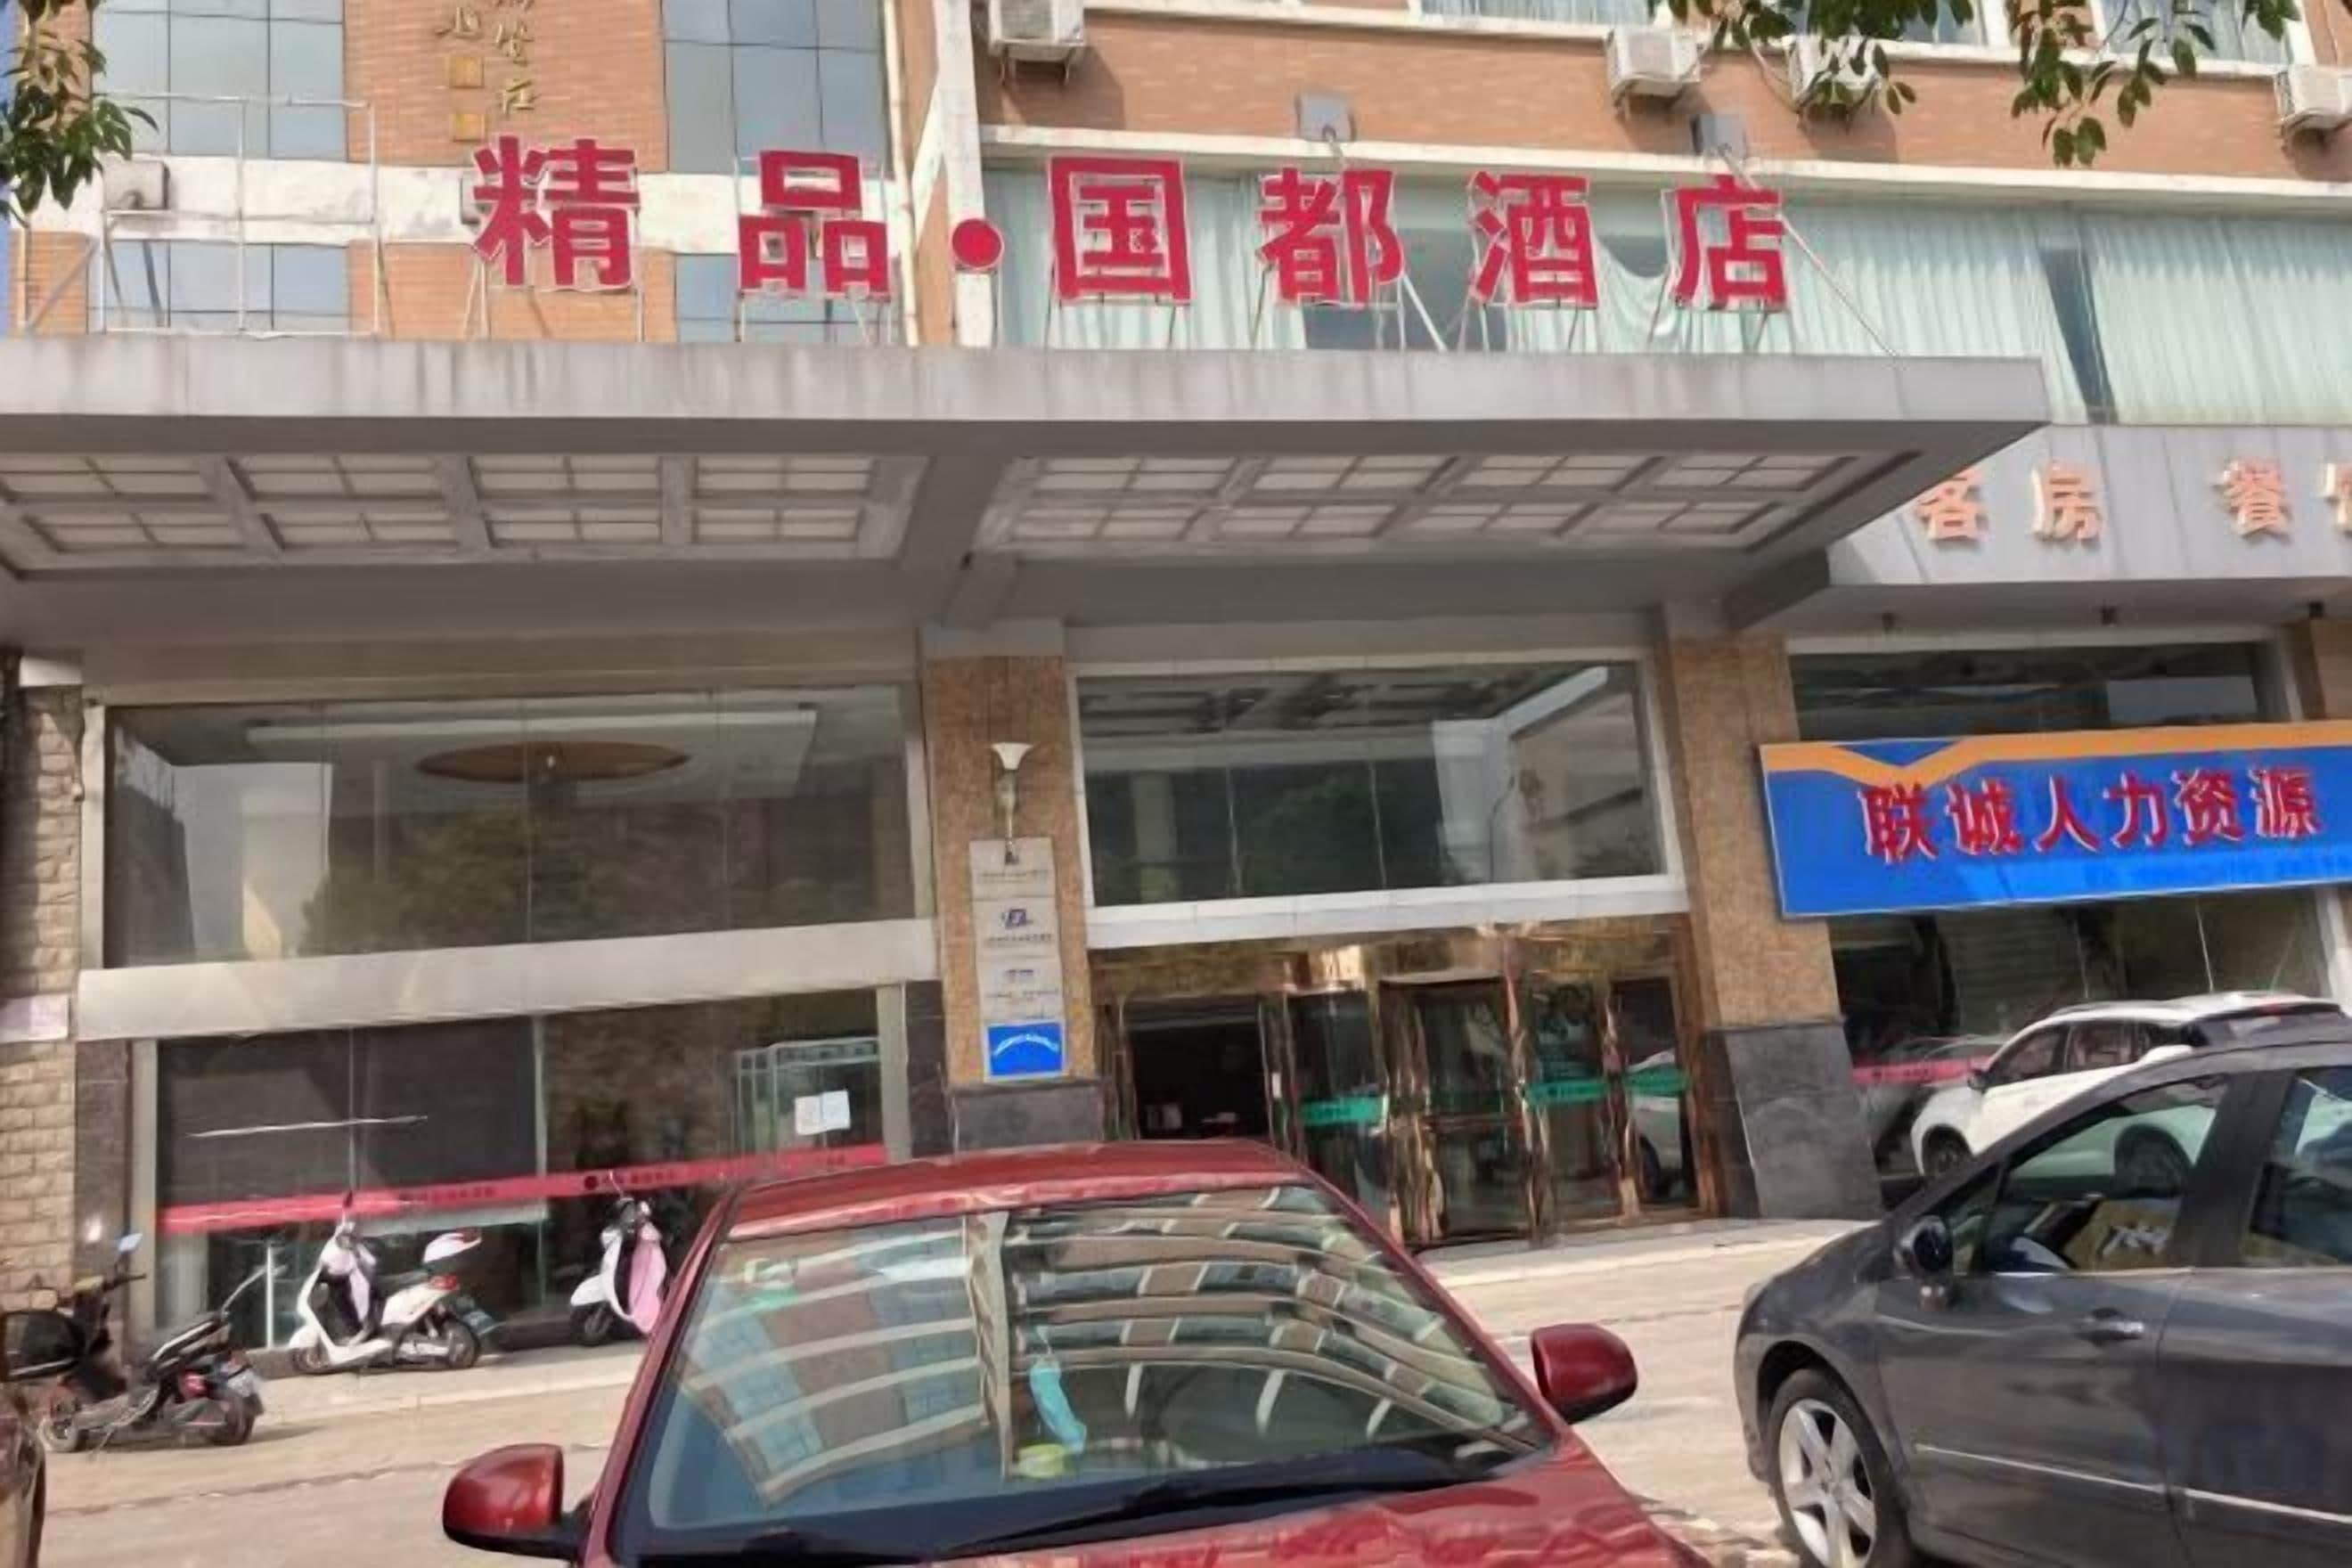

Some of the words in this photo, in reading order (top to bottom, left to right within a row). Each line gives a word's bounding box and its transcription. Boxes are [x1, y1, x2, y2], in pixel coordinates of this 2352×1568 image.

[1858, 767, 2320, 863] 联诚人力资源
